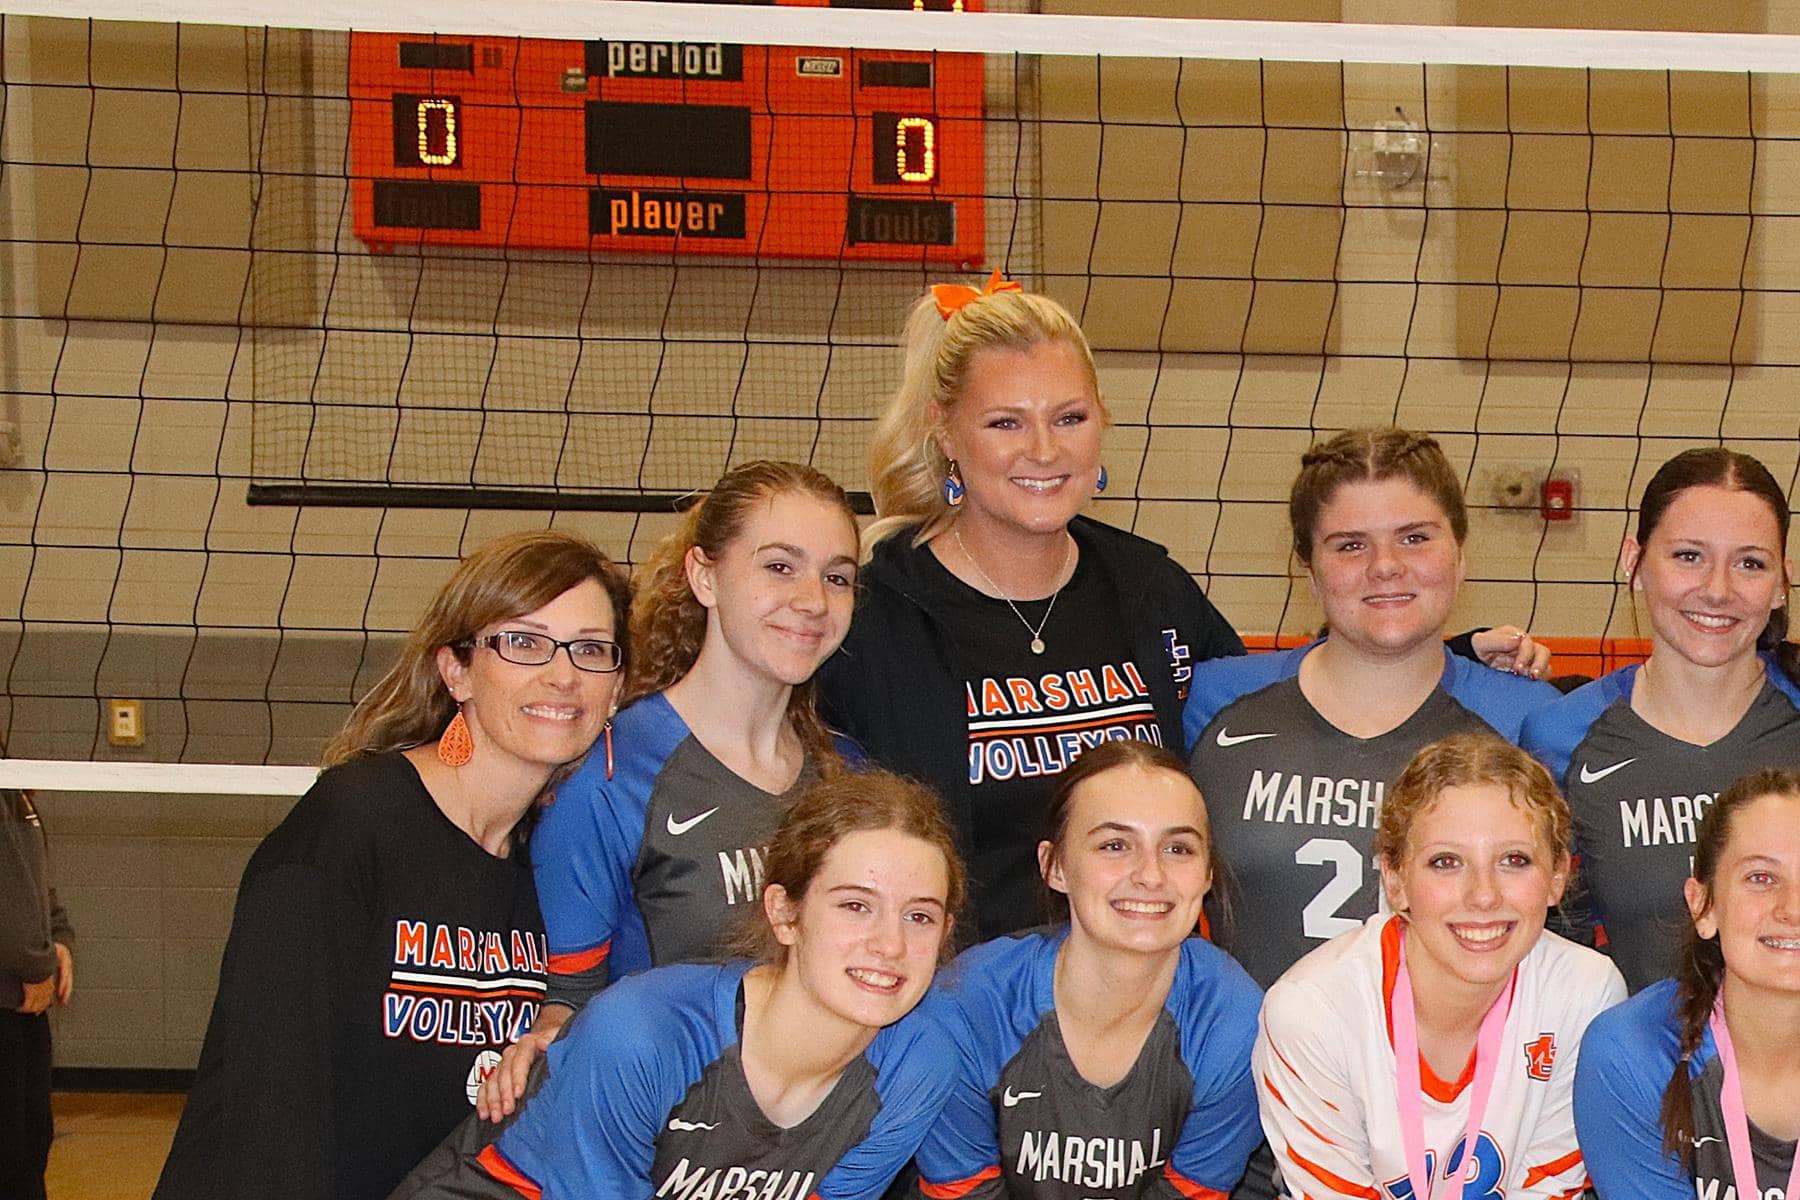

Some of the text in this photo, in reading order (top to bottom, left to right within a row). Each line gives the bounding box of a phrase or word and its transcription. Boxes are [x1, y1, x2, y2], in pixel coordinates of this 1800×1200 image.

[607, 42, 723, 78] period
[418, 99, 457, 165] 0
[896, 117, 935, 182] 0
[610, 191, 724, 237] player
[1243, 770, 1385, 829] MARSH
